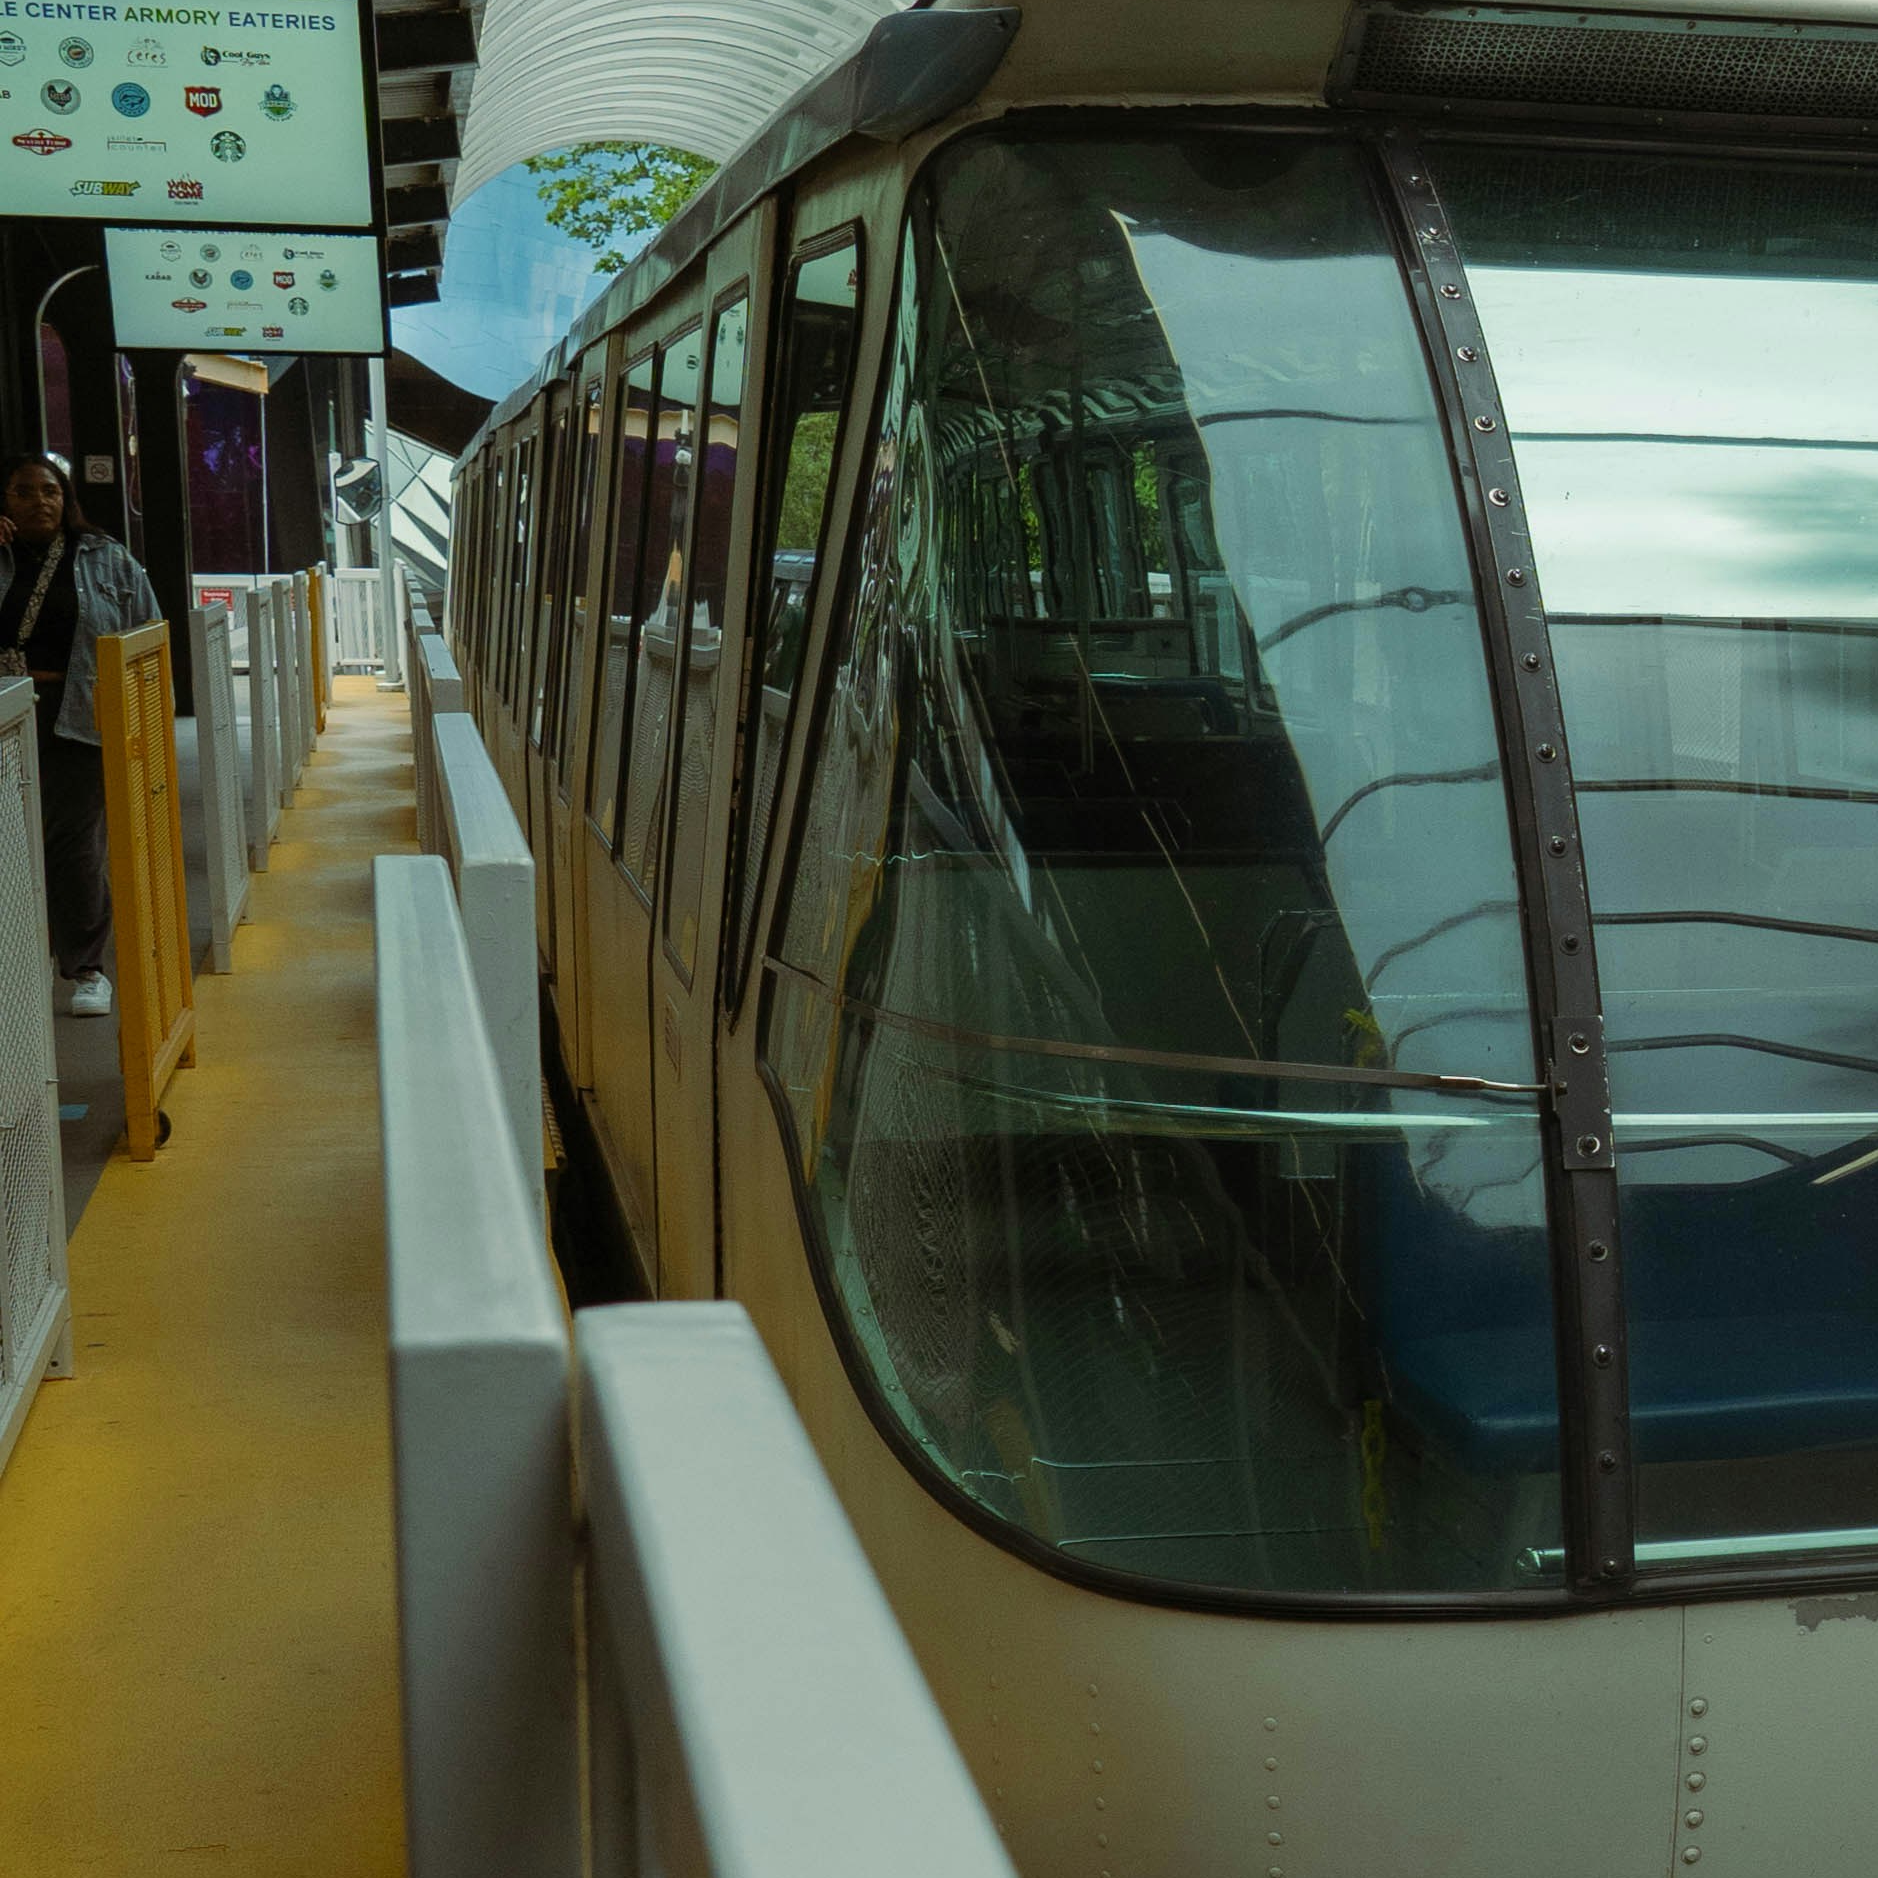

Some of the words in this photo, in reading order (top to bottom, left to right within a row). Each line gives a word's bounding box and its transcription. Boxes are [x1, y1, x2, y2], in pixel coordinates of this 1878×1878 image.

[25, 2, 117, 22] CENTER
[124, 6, 221, 26] ARMORY
[228, 11, 336, 31] EATERIES
[189, 92, 218, 108] MOD
[70, 180, 141, 196] SUBWAY
